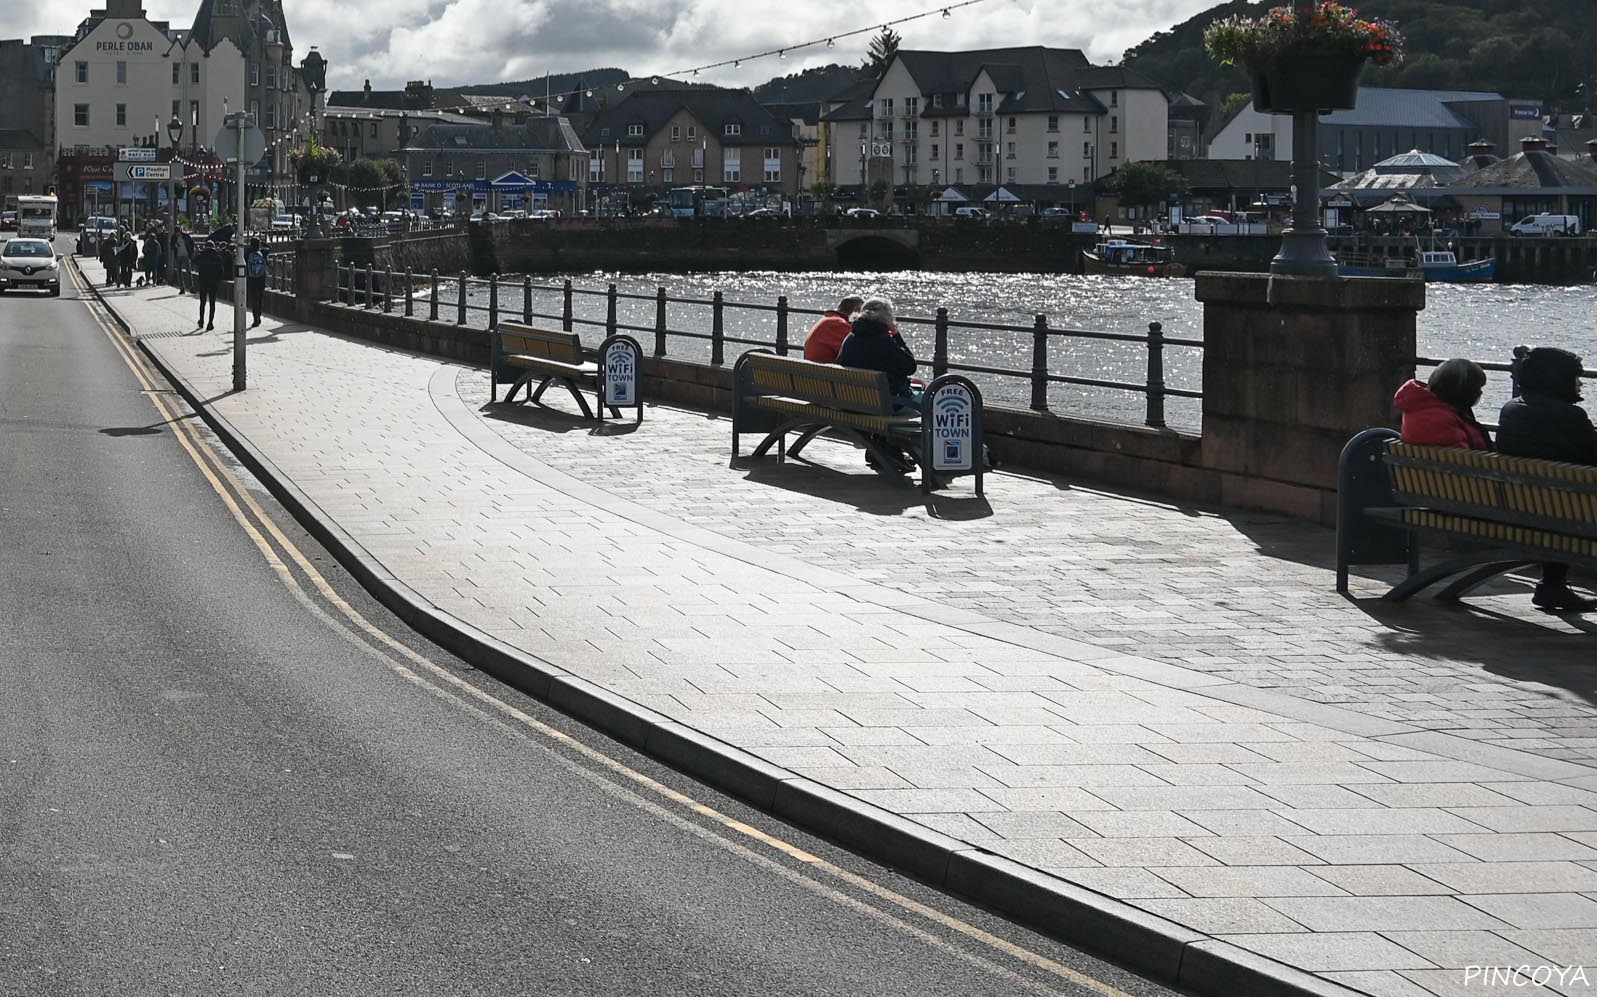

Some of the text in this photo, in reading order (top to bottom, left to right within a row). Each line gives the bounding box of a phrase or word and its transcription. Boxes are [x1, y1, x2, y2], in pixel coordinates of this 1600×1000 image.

[96, 41, 153, 51] PERLE OBAN
[608, 363, 633, 373] WiFi
[608, 374, 633, 382] TOWN
[941, 388, 964, 396] FREE
[936, 413, 969, 427] WiFi
[935, 428, 969, 438] TOWN
